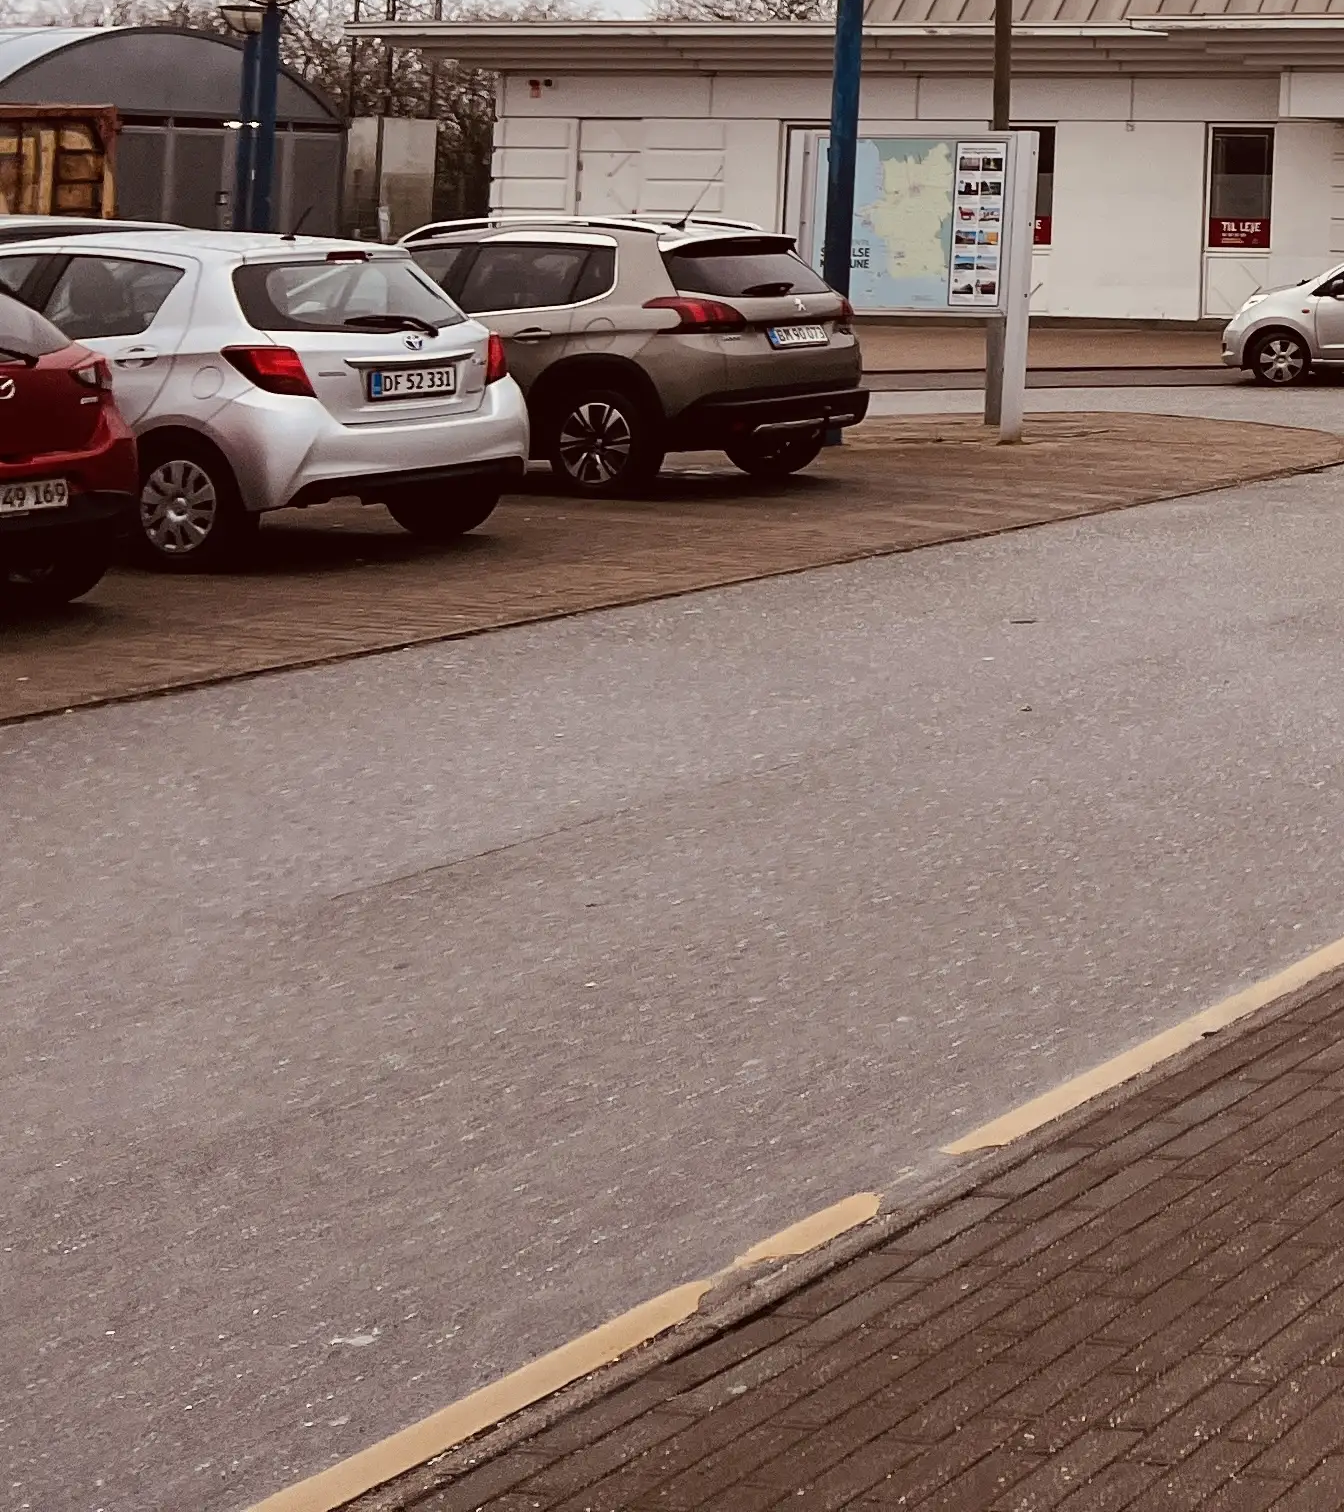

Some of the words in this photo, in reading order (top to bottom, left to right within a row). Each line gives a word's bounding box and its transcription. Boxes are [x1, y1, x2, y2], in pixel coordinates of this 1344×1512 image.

[1221, 221, 1237, 232] TIL
[383, 374, 403, 392] DF
[406, 372, 424, 390] 52
[427, 370, 451, 388] 331
[2, 486, 26, 508] 49
[32, 481, 66, 506] 169
